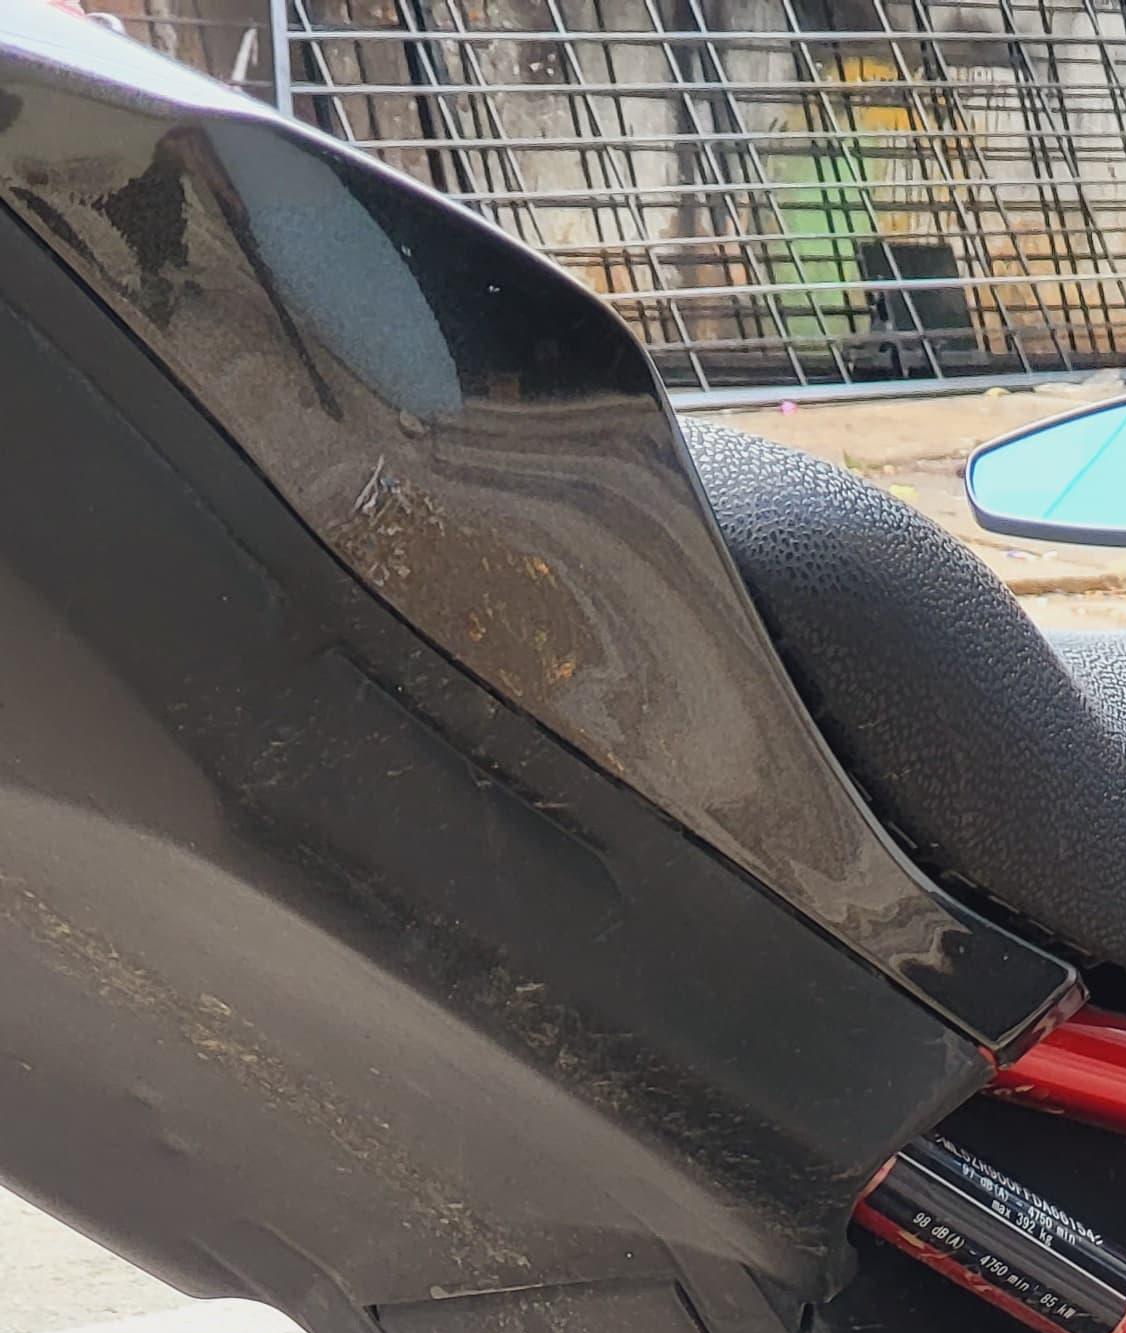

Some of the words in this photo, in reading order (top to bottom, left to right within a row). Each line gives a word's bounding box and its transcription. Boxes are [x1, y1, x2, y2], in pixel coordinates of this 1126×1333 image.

[992, 1199, 1011, 1219] max
[1016, 1212, 1036, 1235] 392
[1039, 1227, 1054, 1247] kg
[931, 1226, 965, 1250] dB(A)
[979, 1255, 1009, 1277] 4750
[1040, 1293, 1056, 1309] 85
